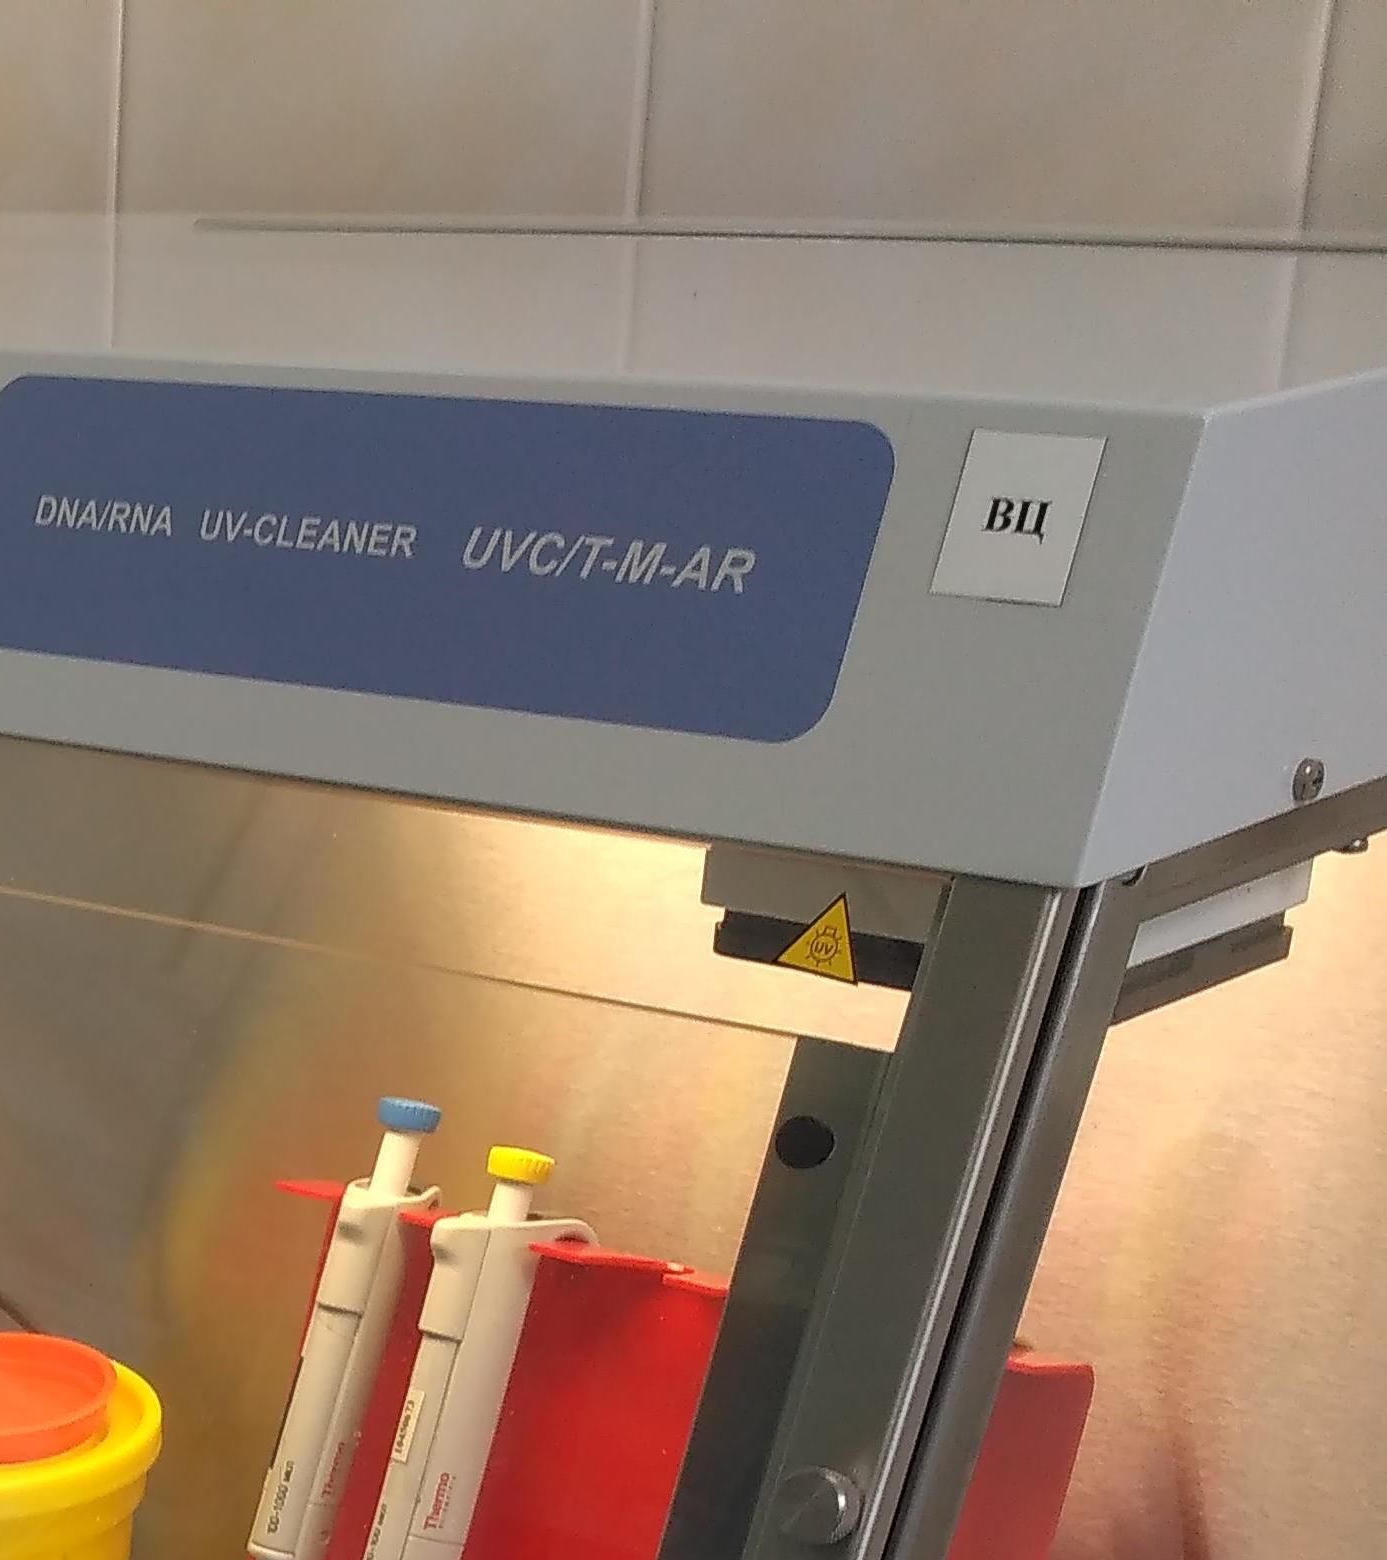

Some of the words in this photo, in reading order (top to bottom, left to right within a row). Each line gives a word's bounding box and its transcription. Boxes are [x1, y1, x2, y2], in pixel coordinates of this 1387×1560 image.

[34, 493, 173, 537] DNA/RNA
[199, 508, 418, 560] UV-CLEANER
[462, 525, 757, 595] UVC/T-M-AR
[981, 497, 1053, 545] ВЦ
[813, 941, 834, 956] UV
[423, 1471, 450, 1530] Thermo
